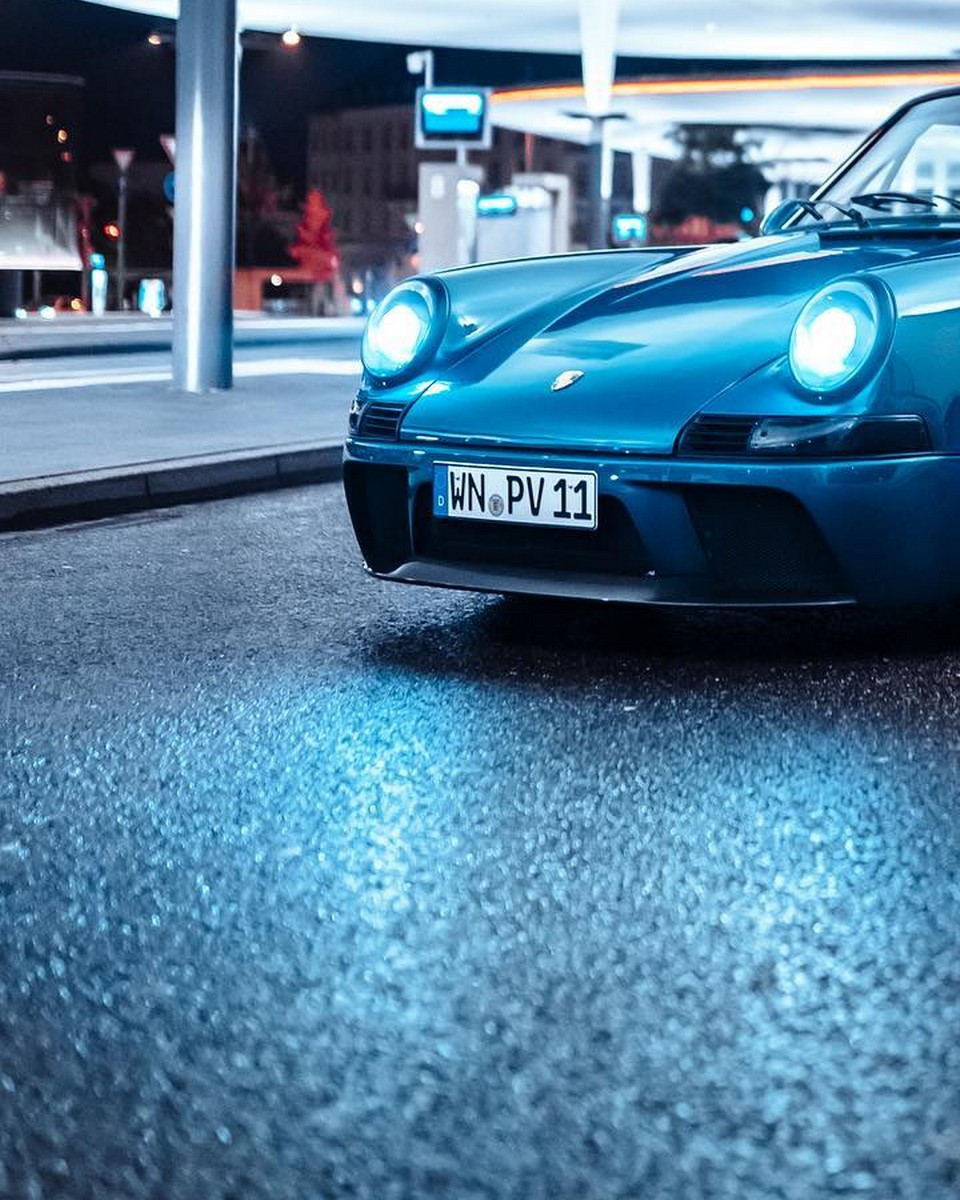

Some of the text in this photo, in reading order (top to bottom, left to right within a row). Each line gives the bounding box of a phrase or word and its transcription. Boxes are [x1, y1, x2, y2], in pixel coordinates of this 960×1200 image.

[437, 495, 445, 507] D
[450, 471, 592, 521] WN PV 11
